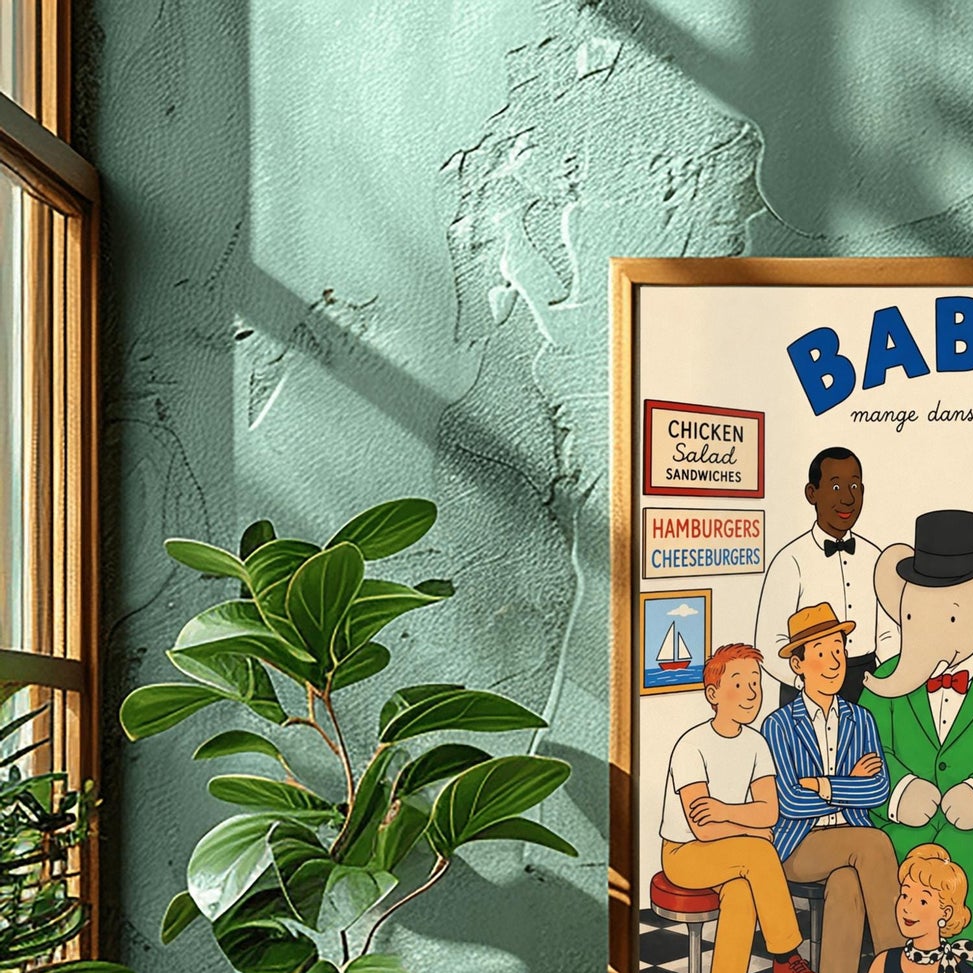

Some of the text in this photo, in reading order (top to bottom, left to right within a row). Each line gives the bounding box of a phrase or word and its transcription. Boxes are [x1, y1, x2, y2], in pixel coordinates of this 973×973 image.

[850, 408, 919, 433] mange
[668, 420, 744, 443] CHICKEN
[672, 442, 737, 465] Salad
[666, 468, 742, 482] SANDWICHES
[652, 518, 760, 538] HAMBURGERS
[651, 548, 760, 568] CHEESEBURGERS
